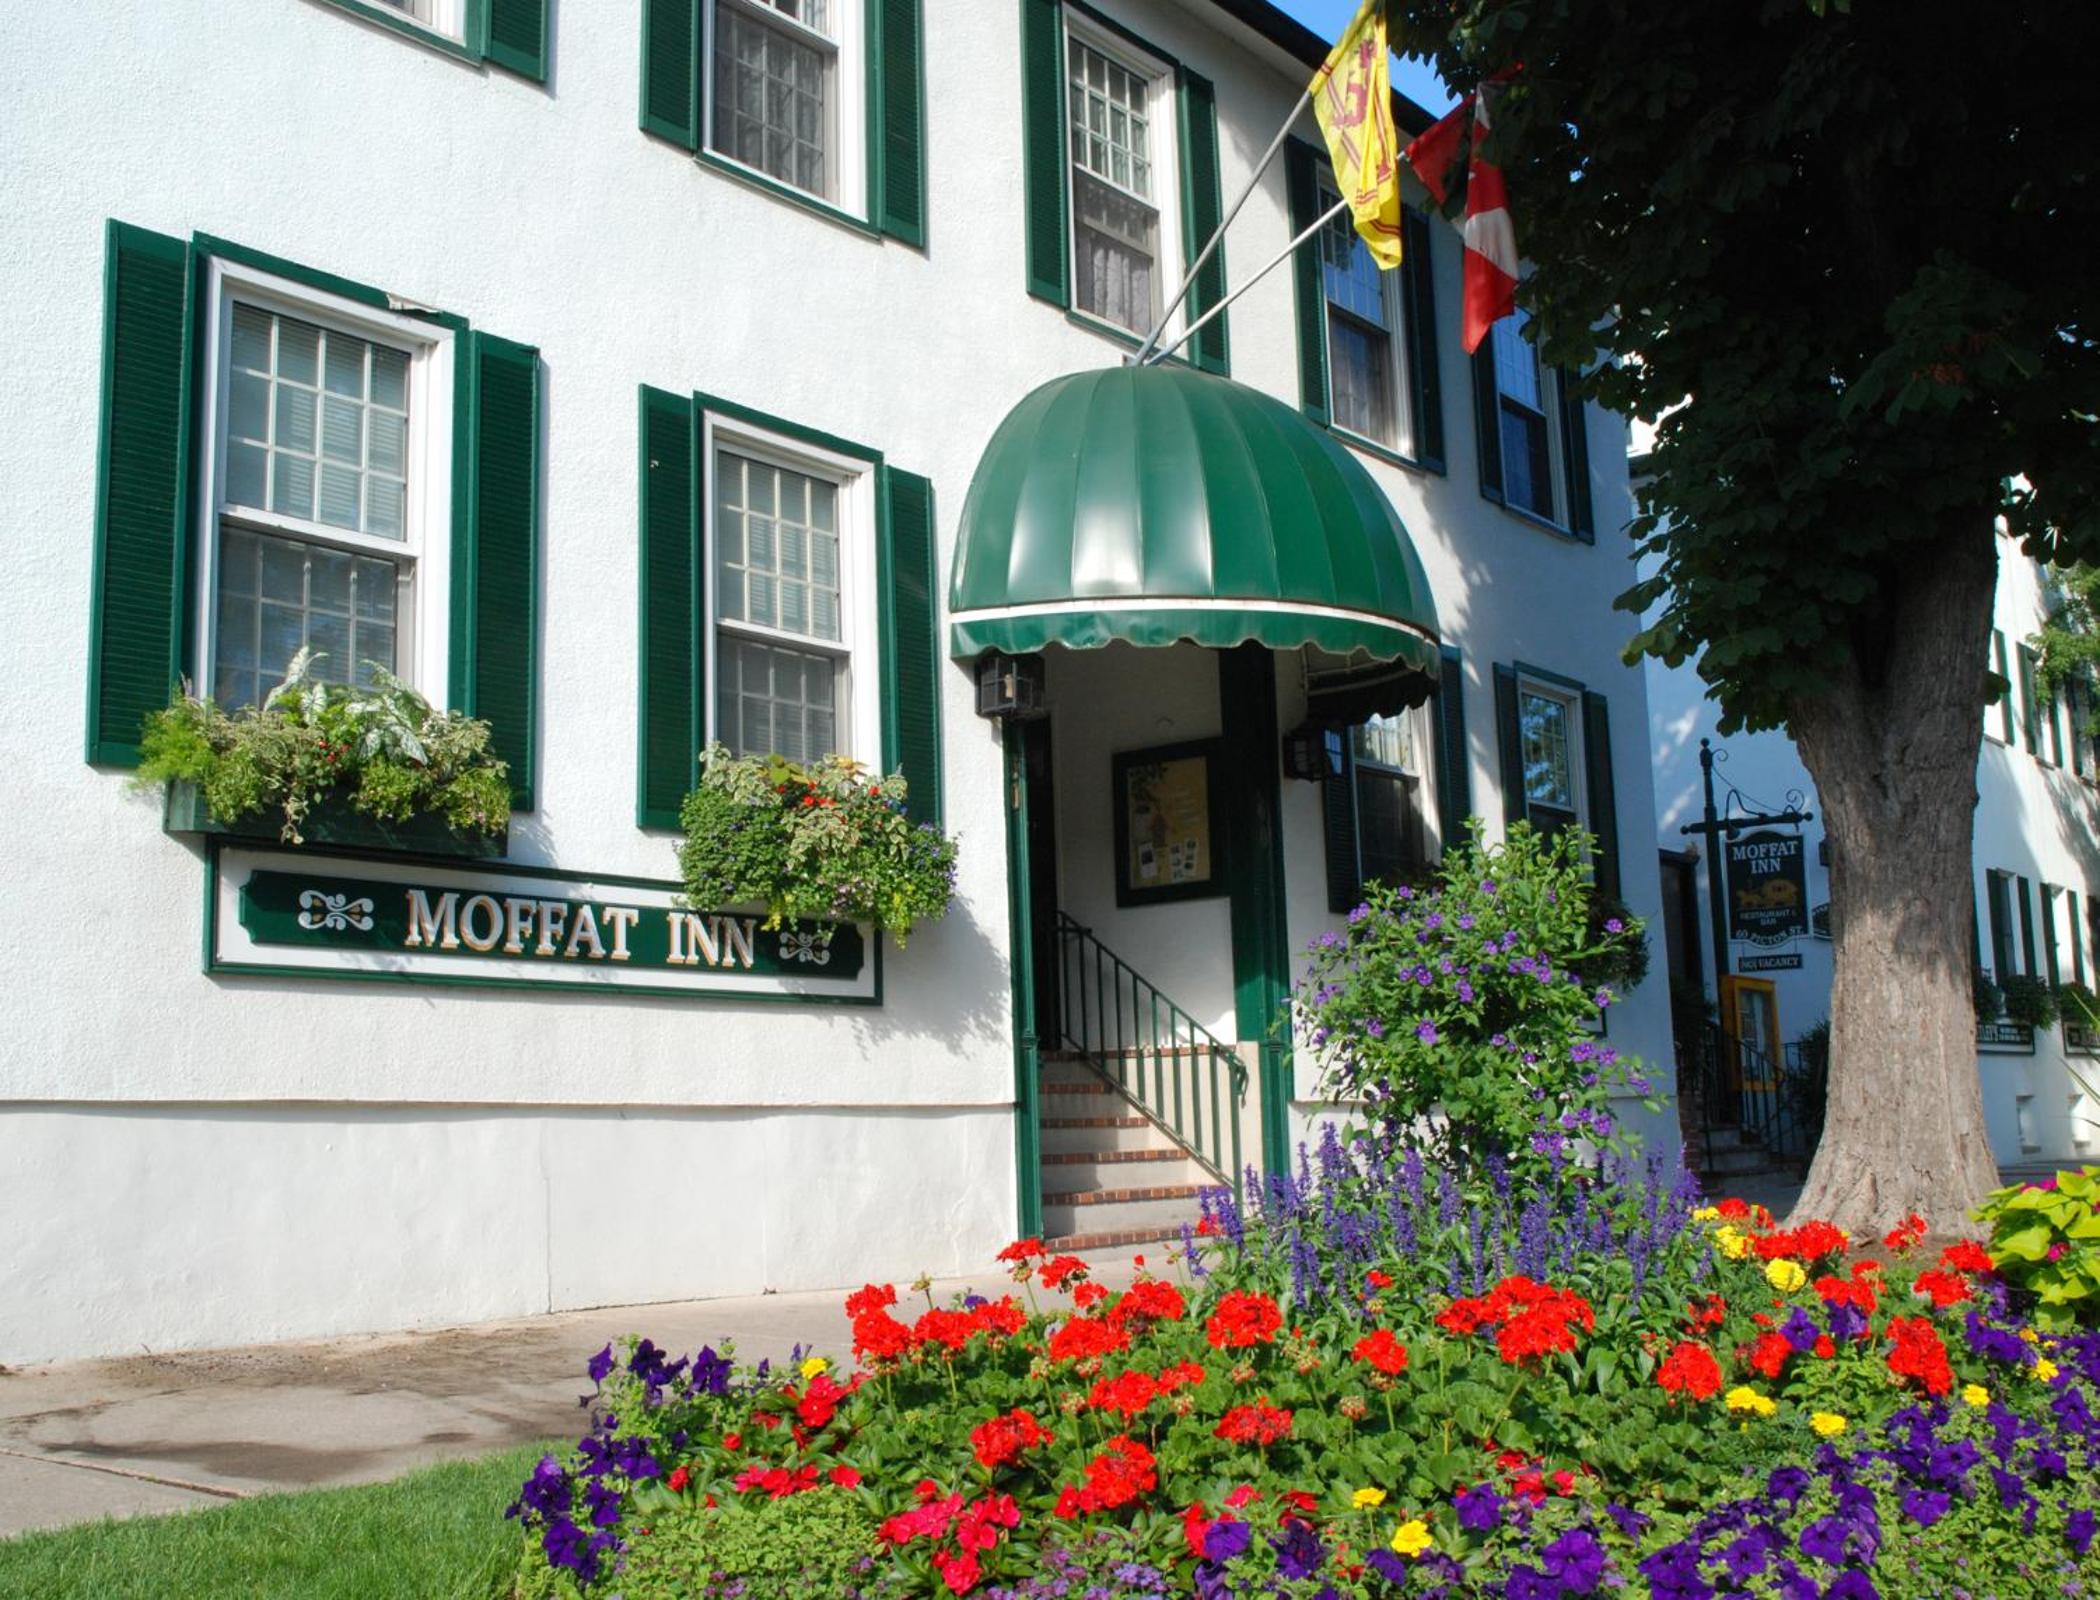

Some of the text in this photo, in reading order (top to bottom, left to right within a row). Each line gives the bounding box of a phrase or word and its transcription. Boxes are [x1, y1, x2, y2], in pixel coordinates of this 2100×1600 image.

[1733, 841, 1799, 861] MOFFAT
[1751, 858, 1782, 874] INN
[404, 889, 757, 968] MOFFAT INN
[1750, 930, 1788, 945] PICTON
[1758, 957, 1799, 968] VACANCY
